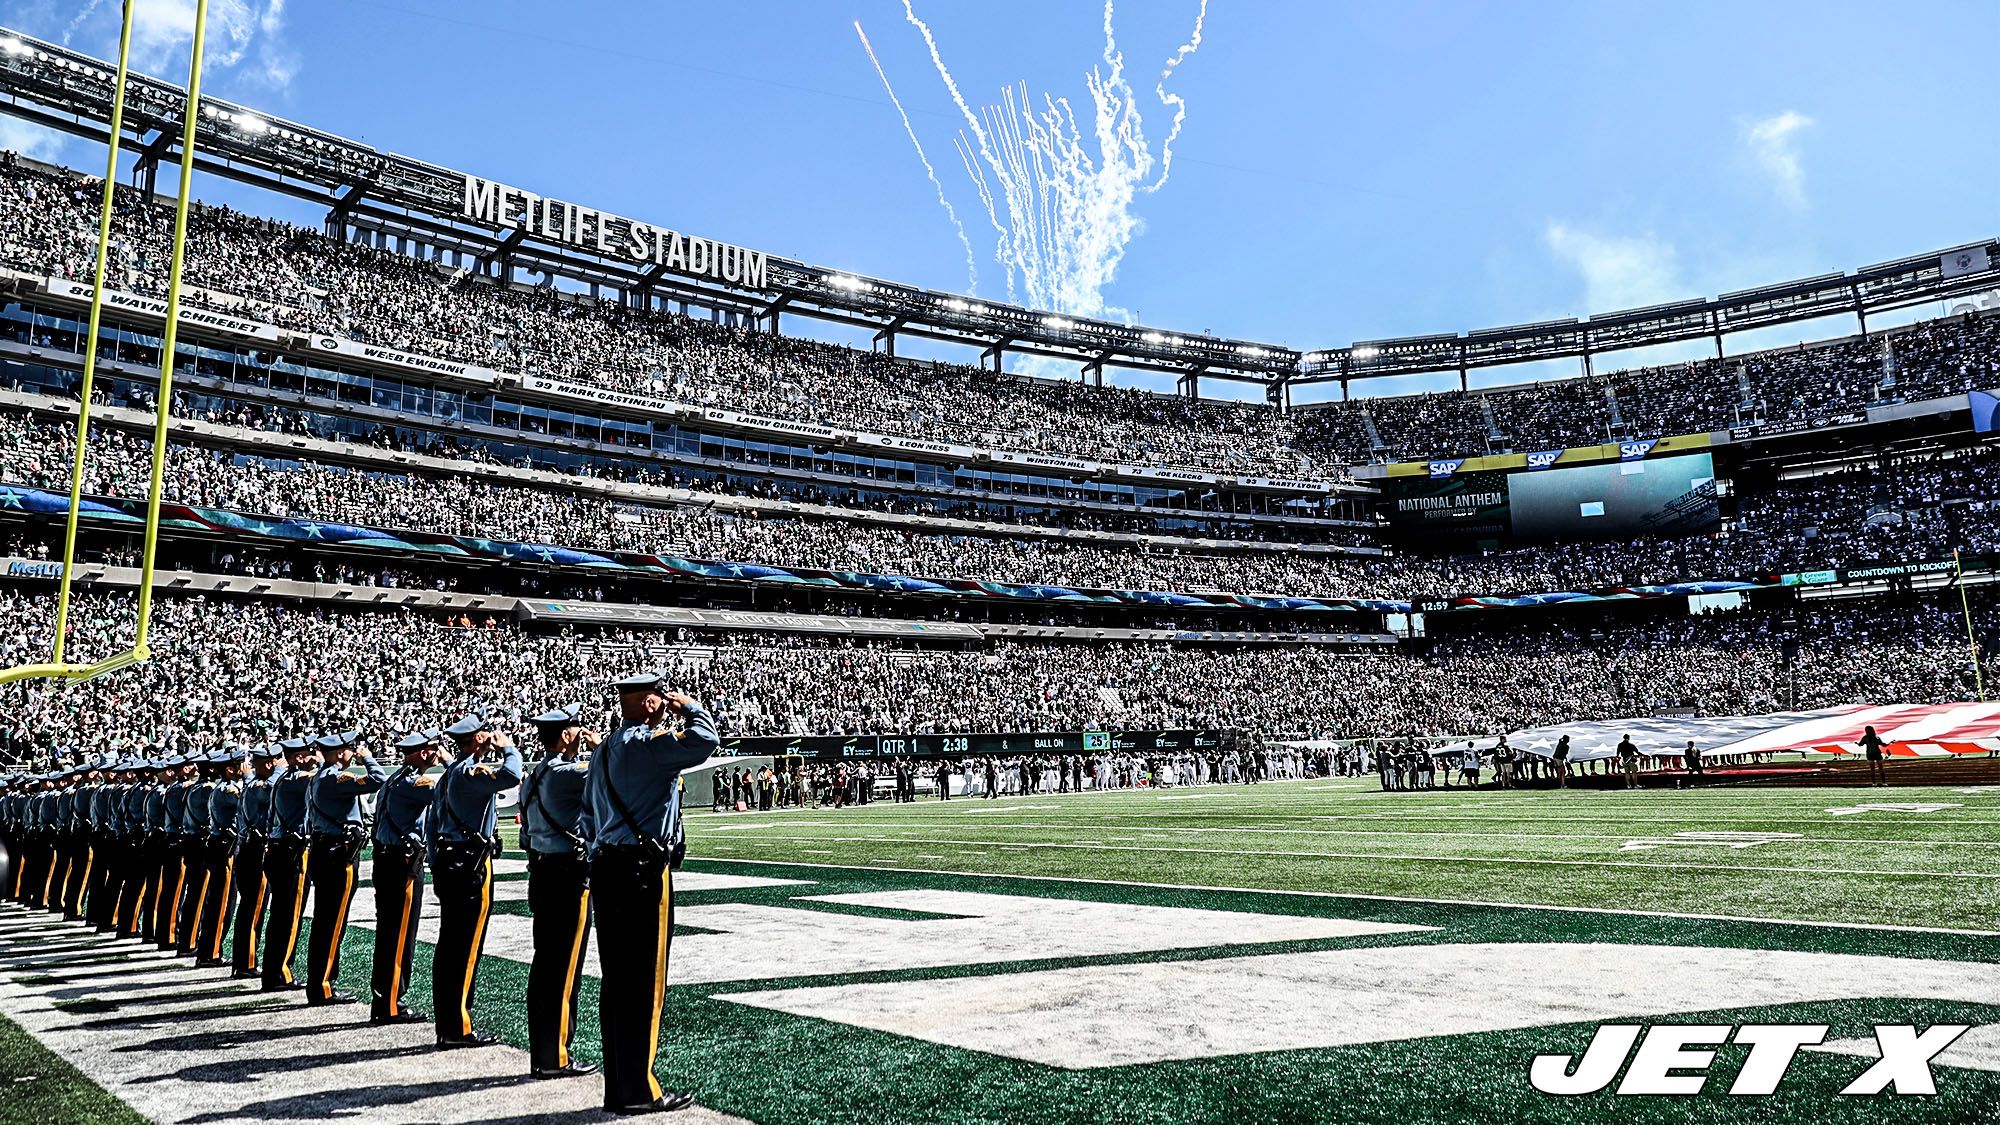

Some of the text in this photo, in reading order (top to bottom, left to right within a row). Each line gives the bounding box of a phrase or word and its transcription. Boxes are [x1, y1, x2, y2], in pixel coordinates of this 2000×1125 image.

[463, 174, 768, 289] METLIFE STADIUM
[69, 286, 95, 297] 80
[178, 309, 262, 334] CHREBET
[364, 347, 466, 375] WEEB EWBANK
[534, 380, 666, 410] 99 MARK GASTINEAU
[708, 411, 833, 436] 60 LARRY GRANTHAM
[898, 440, 950, 453] LEON HESS
[1620, 442, 1651, 458] SAP
[1002, 453, 1086, 469] 75 WINSTON HILL
[1527, 452, 1556, 468] SAP
[1155, 470, 1172, 478] JOE
[1172, 472, 1204, 480] KLECKO
[1429, 461, 1458, 477] SAP
[1268, 480, 1297, 488] MARTY
[1296, 482, 1322, 490] LYONS
[1398, 492, 1502, 511] NATIONAL ANTHEM
[7, 560, 64, 577] MetLif
[1847, 560, 1959, 578] COUNTDOWN TO KICKOFF
[1421, 601, 1449, 611] 12:59
[882, 739, 906, 754] QTR
[911, 738, 918, 753] 1
[942, 738, 969, 752] 2:38
[1002, 740, 1009, 750] &
[1034, 738, 1064, 748] BALL ON
[1091, 735, 1103, 747] 25
[1112, 739, 1122, 749] EY
[1156, 738, 1165, 748] EY
[1194, 737, 1204, 747] EY
[786, 746, 800, 756] EY
[842, 745, 856, 756] EY
